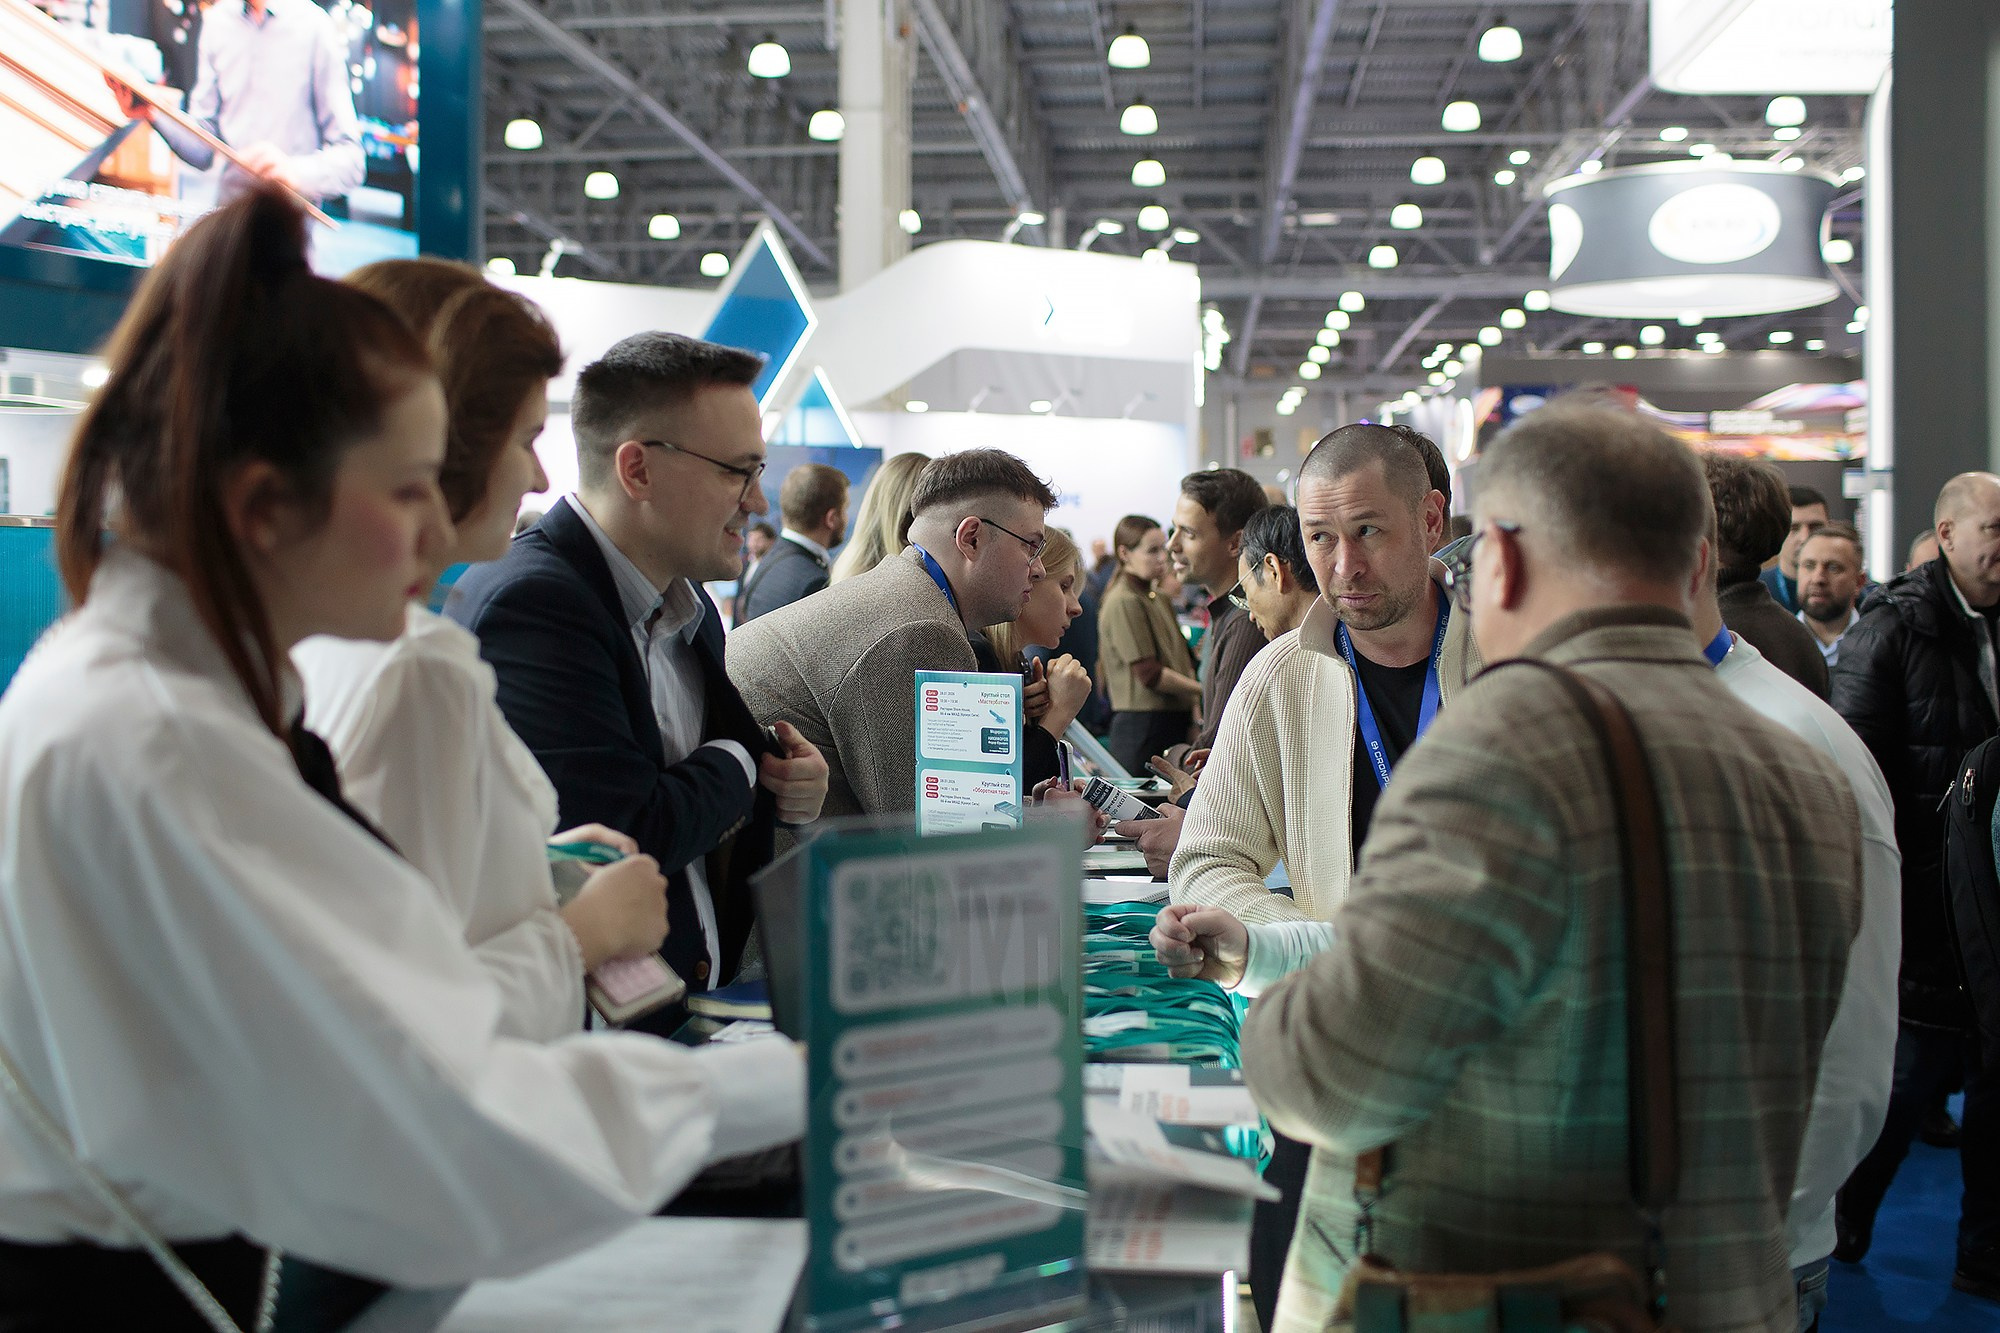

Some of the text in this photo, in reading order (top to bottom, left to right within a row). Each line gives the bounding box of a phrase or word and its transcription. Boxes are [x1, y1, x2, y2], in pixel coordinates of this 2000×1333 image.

[1340, 635, 1351, 665] CRONP
[981, 691, 999, 699] Круглый
[1374, 751, 1391, 788] CRONPL
